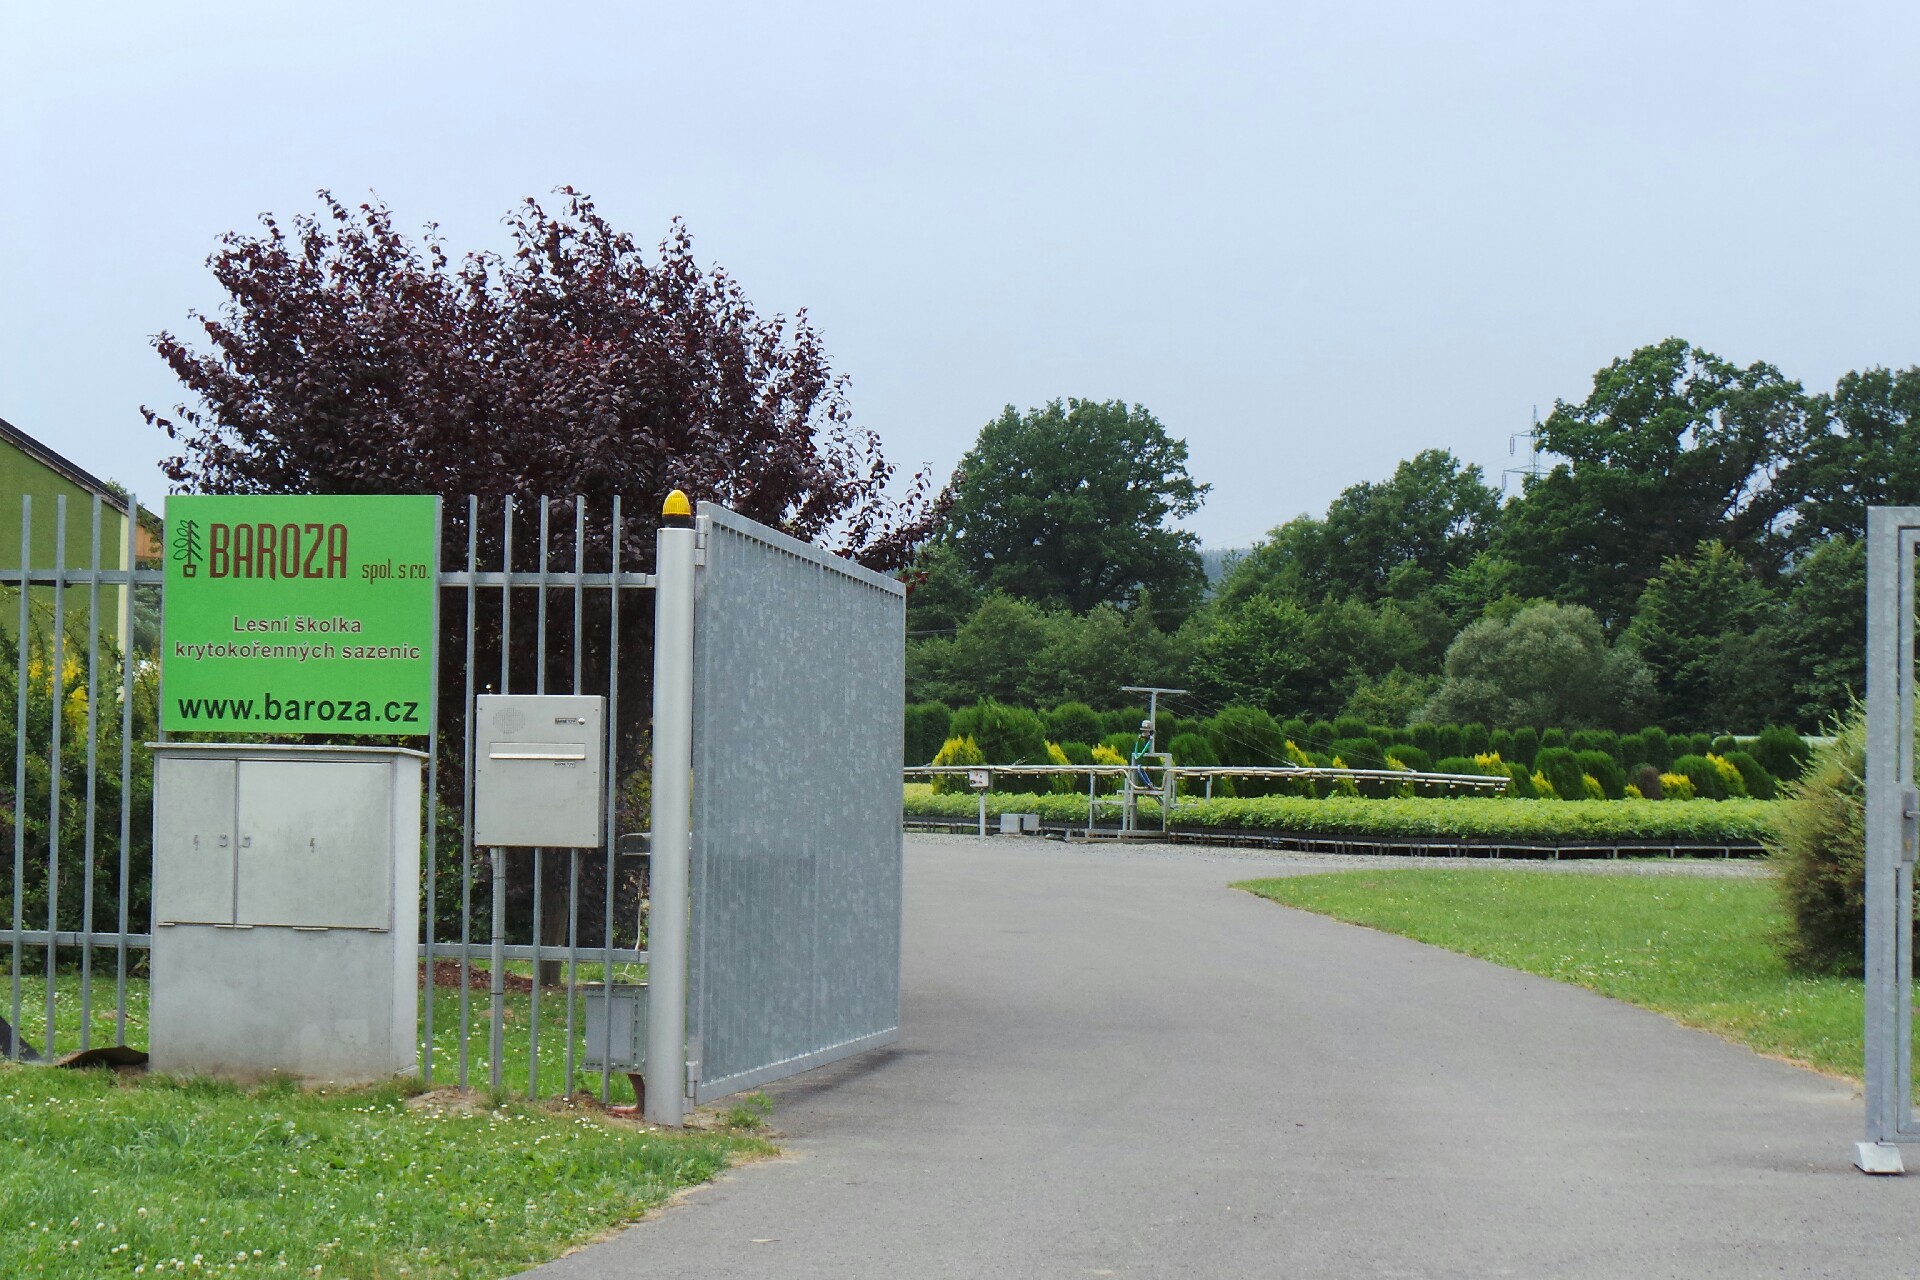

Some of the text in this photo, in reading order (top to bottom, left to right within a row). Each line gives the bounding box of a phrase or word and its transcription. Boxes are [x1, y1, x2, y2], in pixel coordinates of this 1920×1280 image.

[209, 523, 431, 584] BAROZA spol. s r.o.
[233, 615, 362, 633] Lesní školka
[175, 641, 421, 662] krytokořenných sazenic
[178, 692, 418, 722] www.baroza.cz
